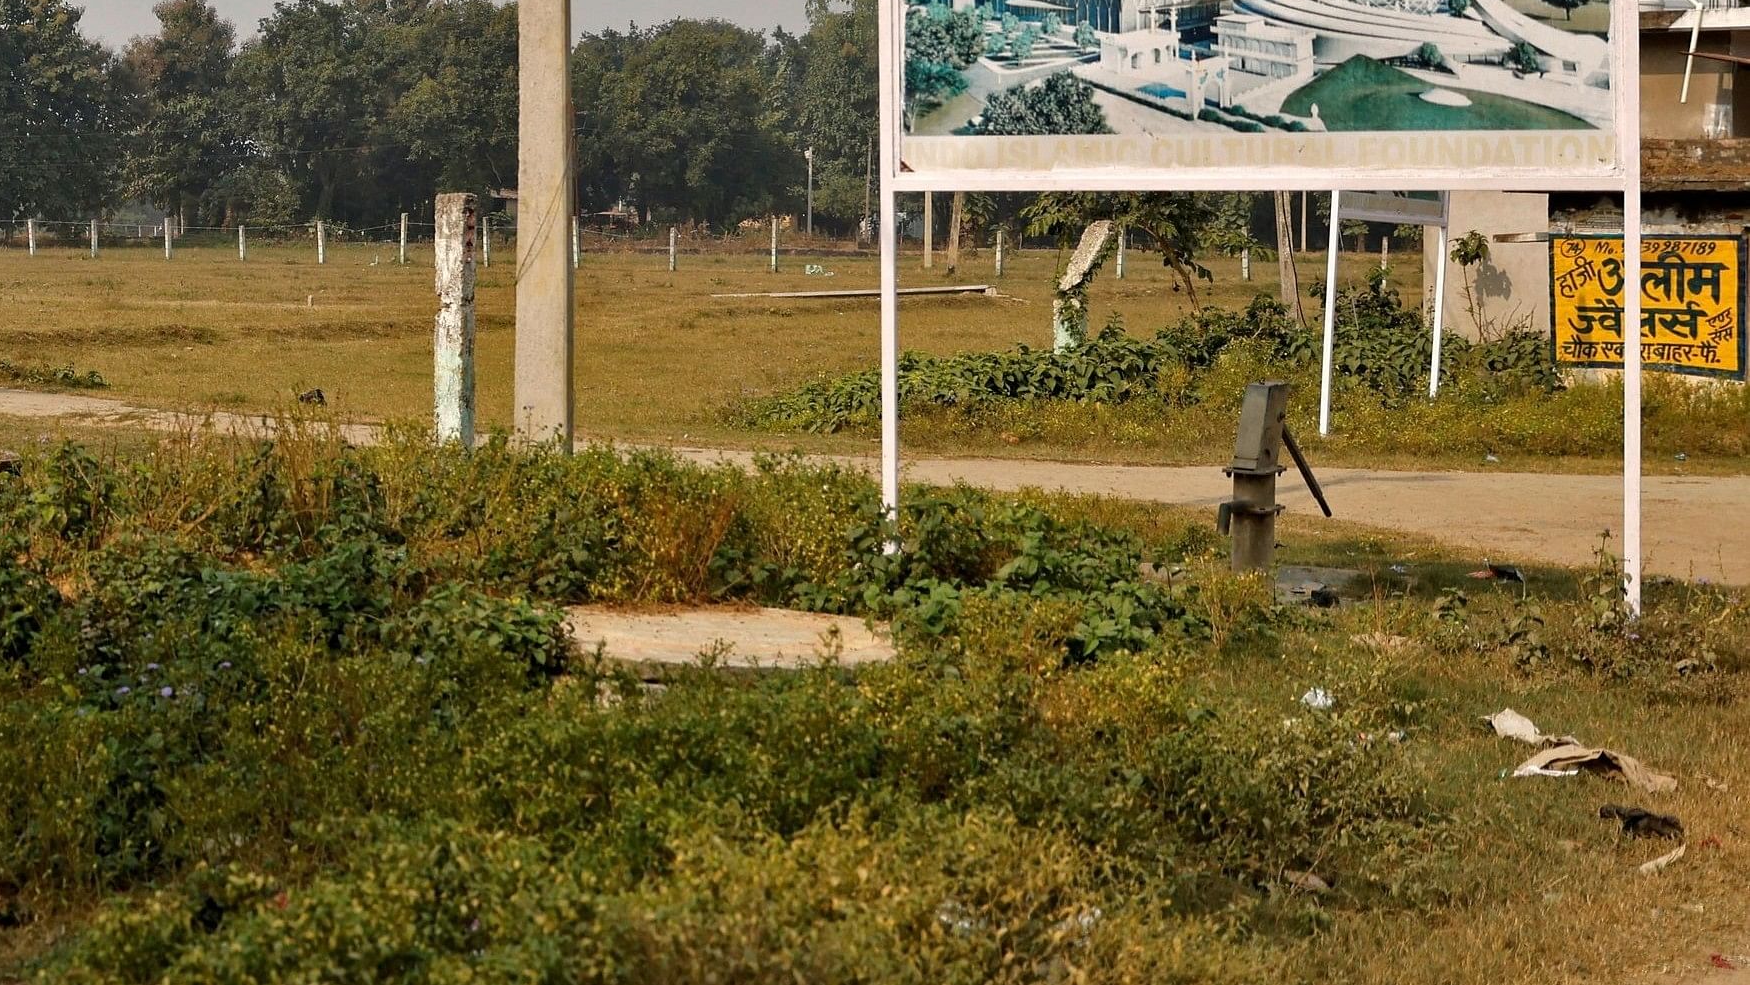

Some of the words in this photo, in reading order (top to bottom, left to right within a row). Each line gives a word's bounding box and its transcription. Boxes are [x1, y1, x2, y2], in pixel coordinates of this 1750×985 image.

[904, 142, 987, 170] INDO
[996, 138, 1138, 170] ISLAMIC
[1151, 137, 1335, 166] CULTURAL
[1357, 135, 1617, 166] FOUNDATION
[1561, 334, 1600, 359] चौक
